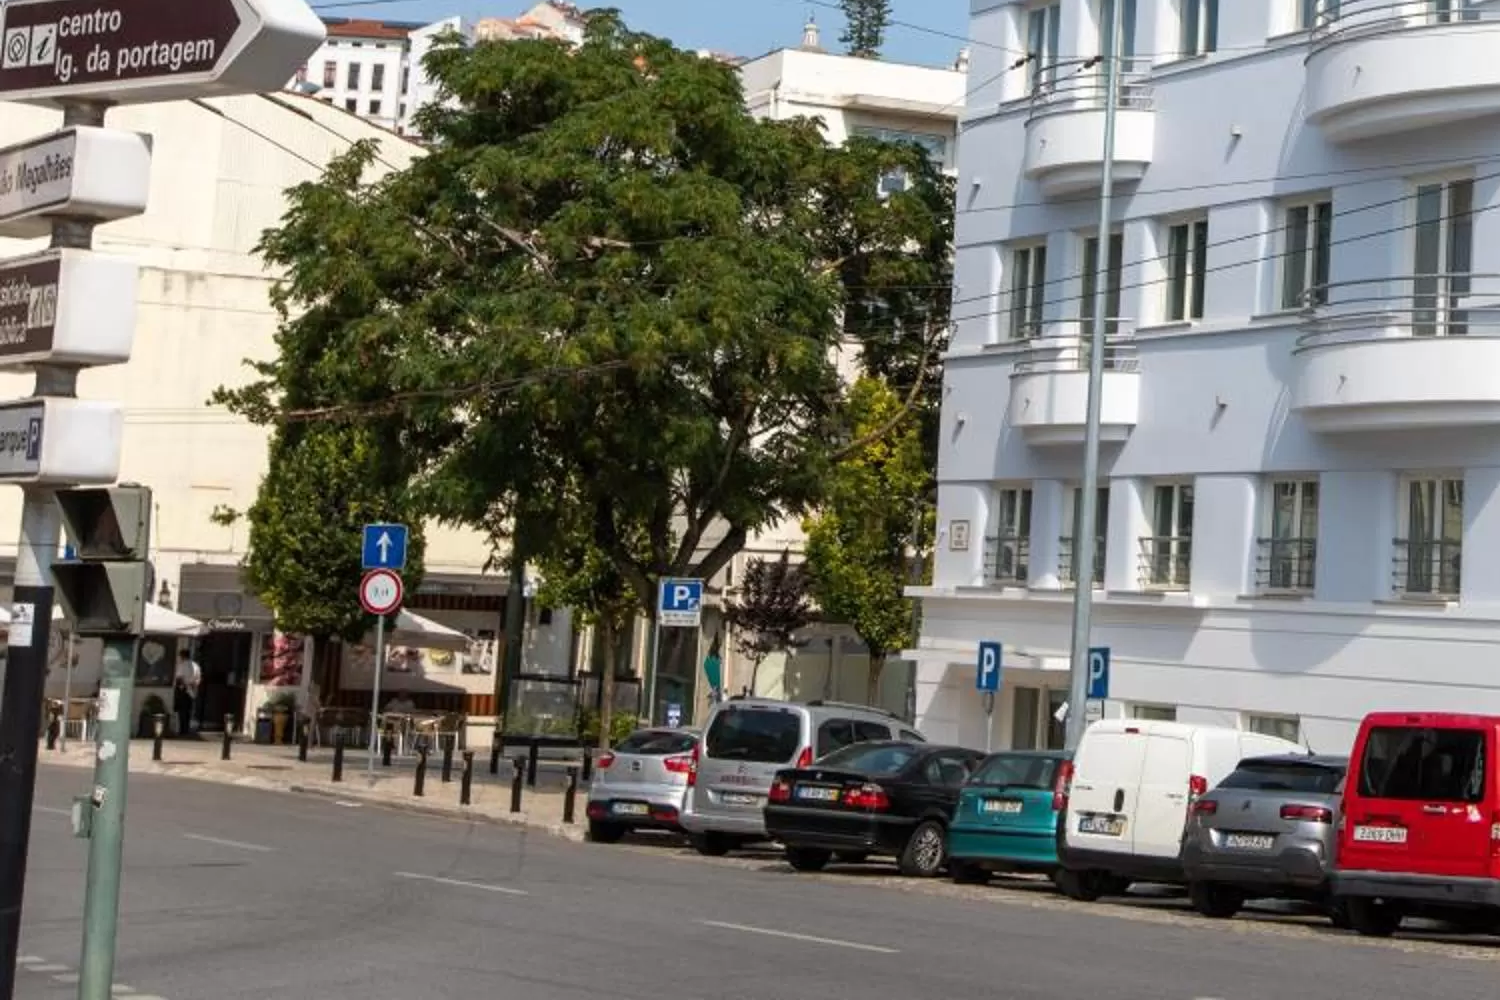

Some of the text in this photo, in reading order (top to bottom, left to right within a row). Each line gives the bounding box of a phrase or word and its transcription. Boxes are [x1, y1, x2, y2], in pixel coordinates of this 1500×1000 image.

[59, 9, 121, 37] centro
[87, 46, 110, 73] da
[116, 36, 215, 76] portagem
[673, 585, 690, 608] P
[982, 649, 995, 688] P
[1089, 652, 1104, 694] P
